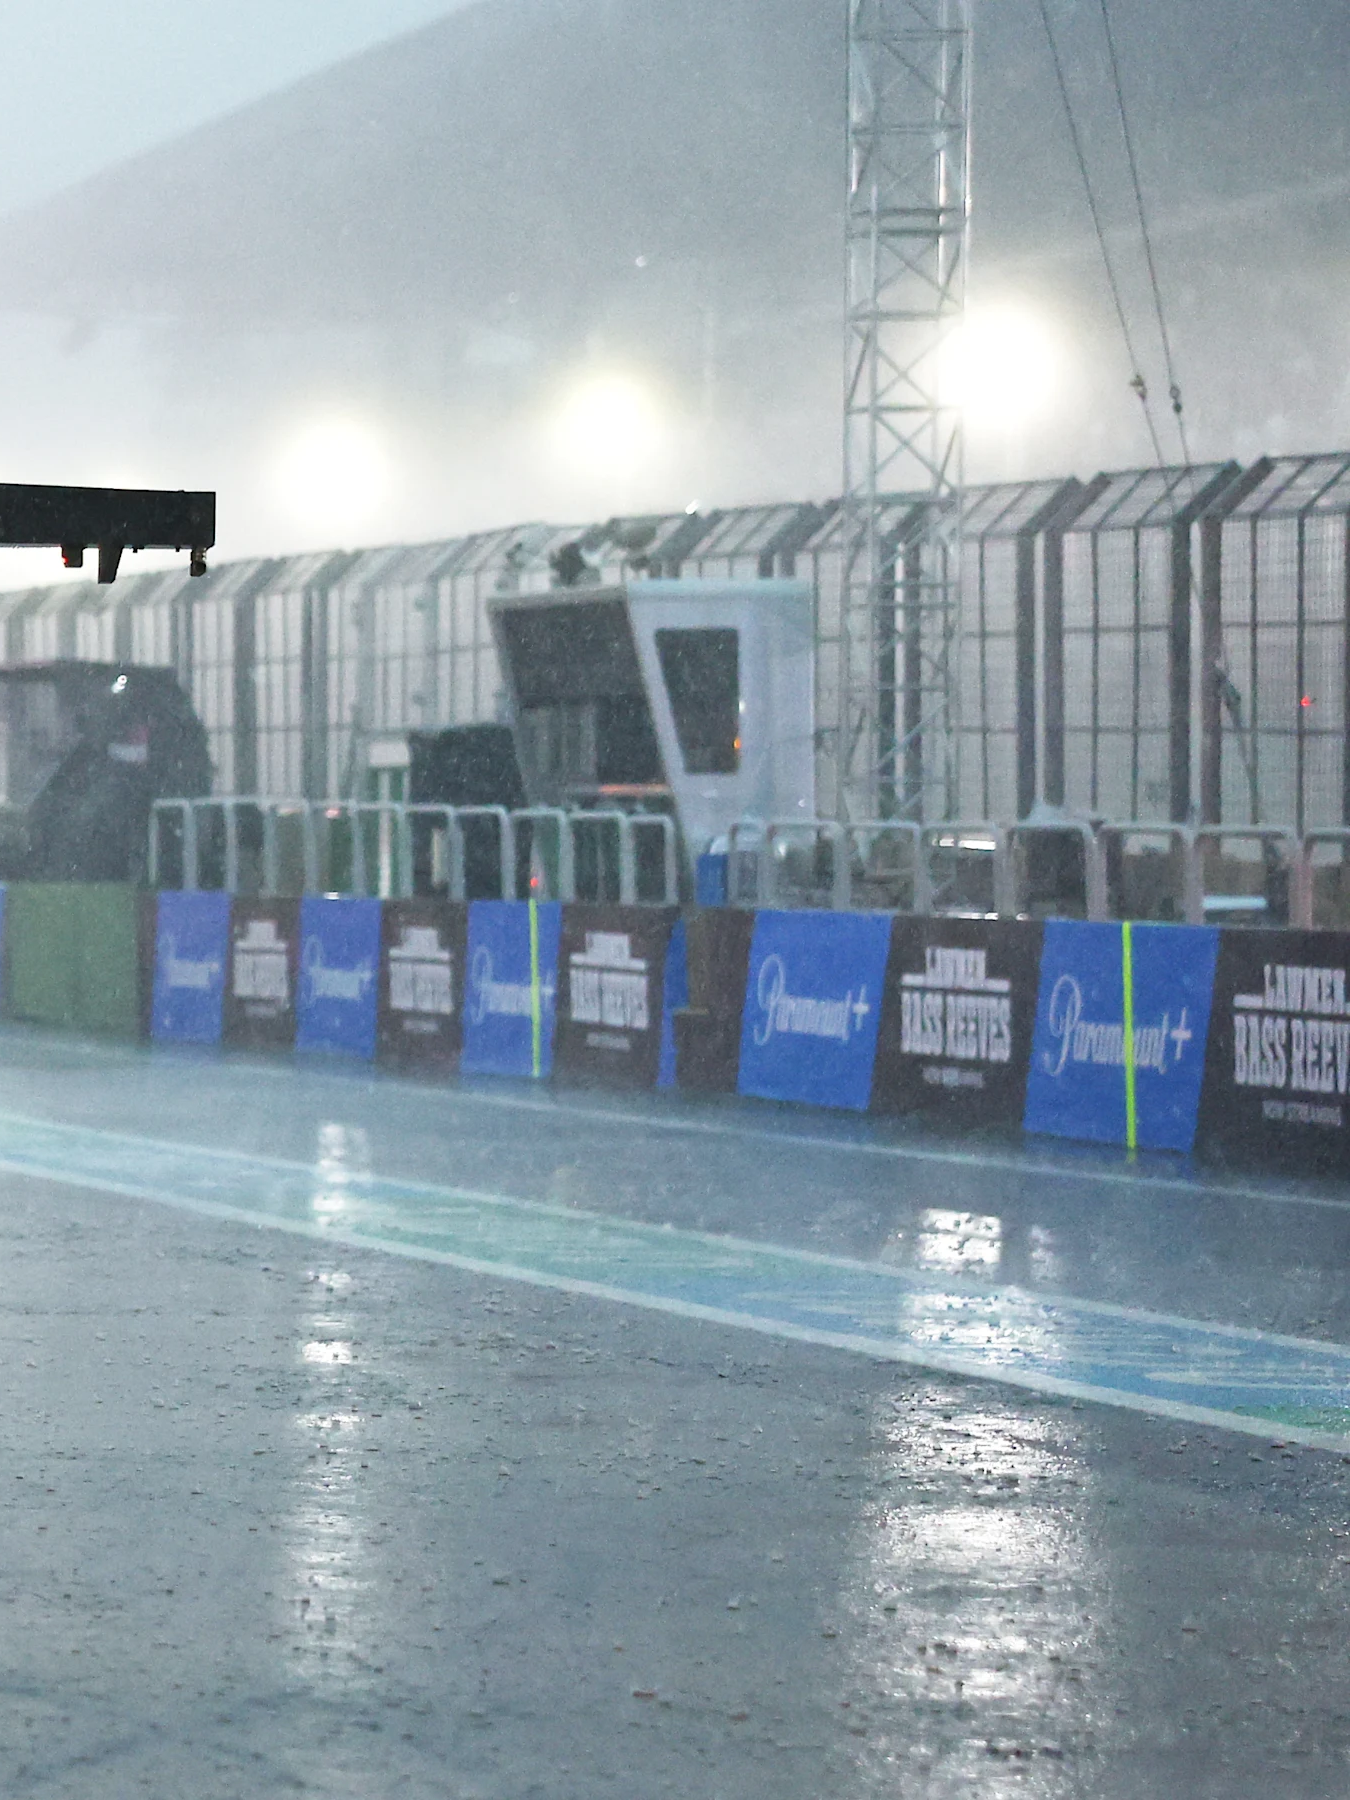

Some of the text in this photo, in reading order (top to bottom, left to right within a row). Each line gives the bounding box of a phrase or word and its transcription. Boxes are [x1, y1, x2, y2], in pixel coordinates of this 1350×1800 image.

[1043, 974, 1193, 1078] Paramunt+
[1233, 1014, 1350, 1095] BASS REEV
